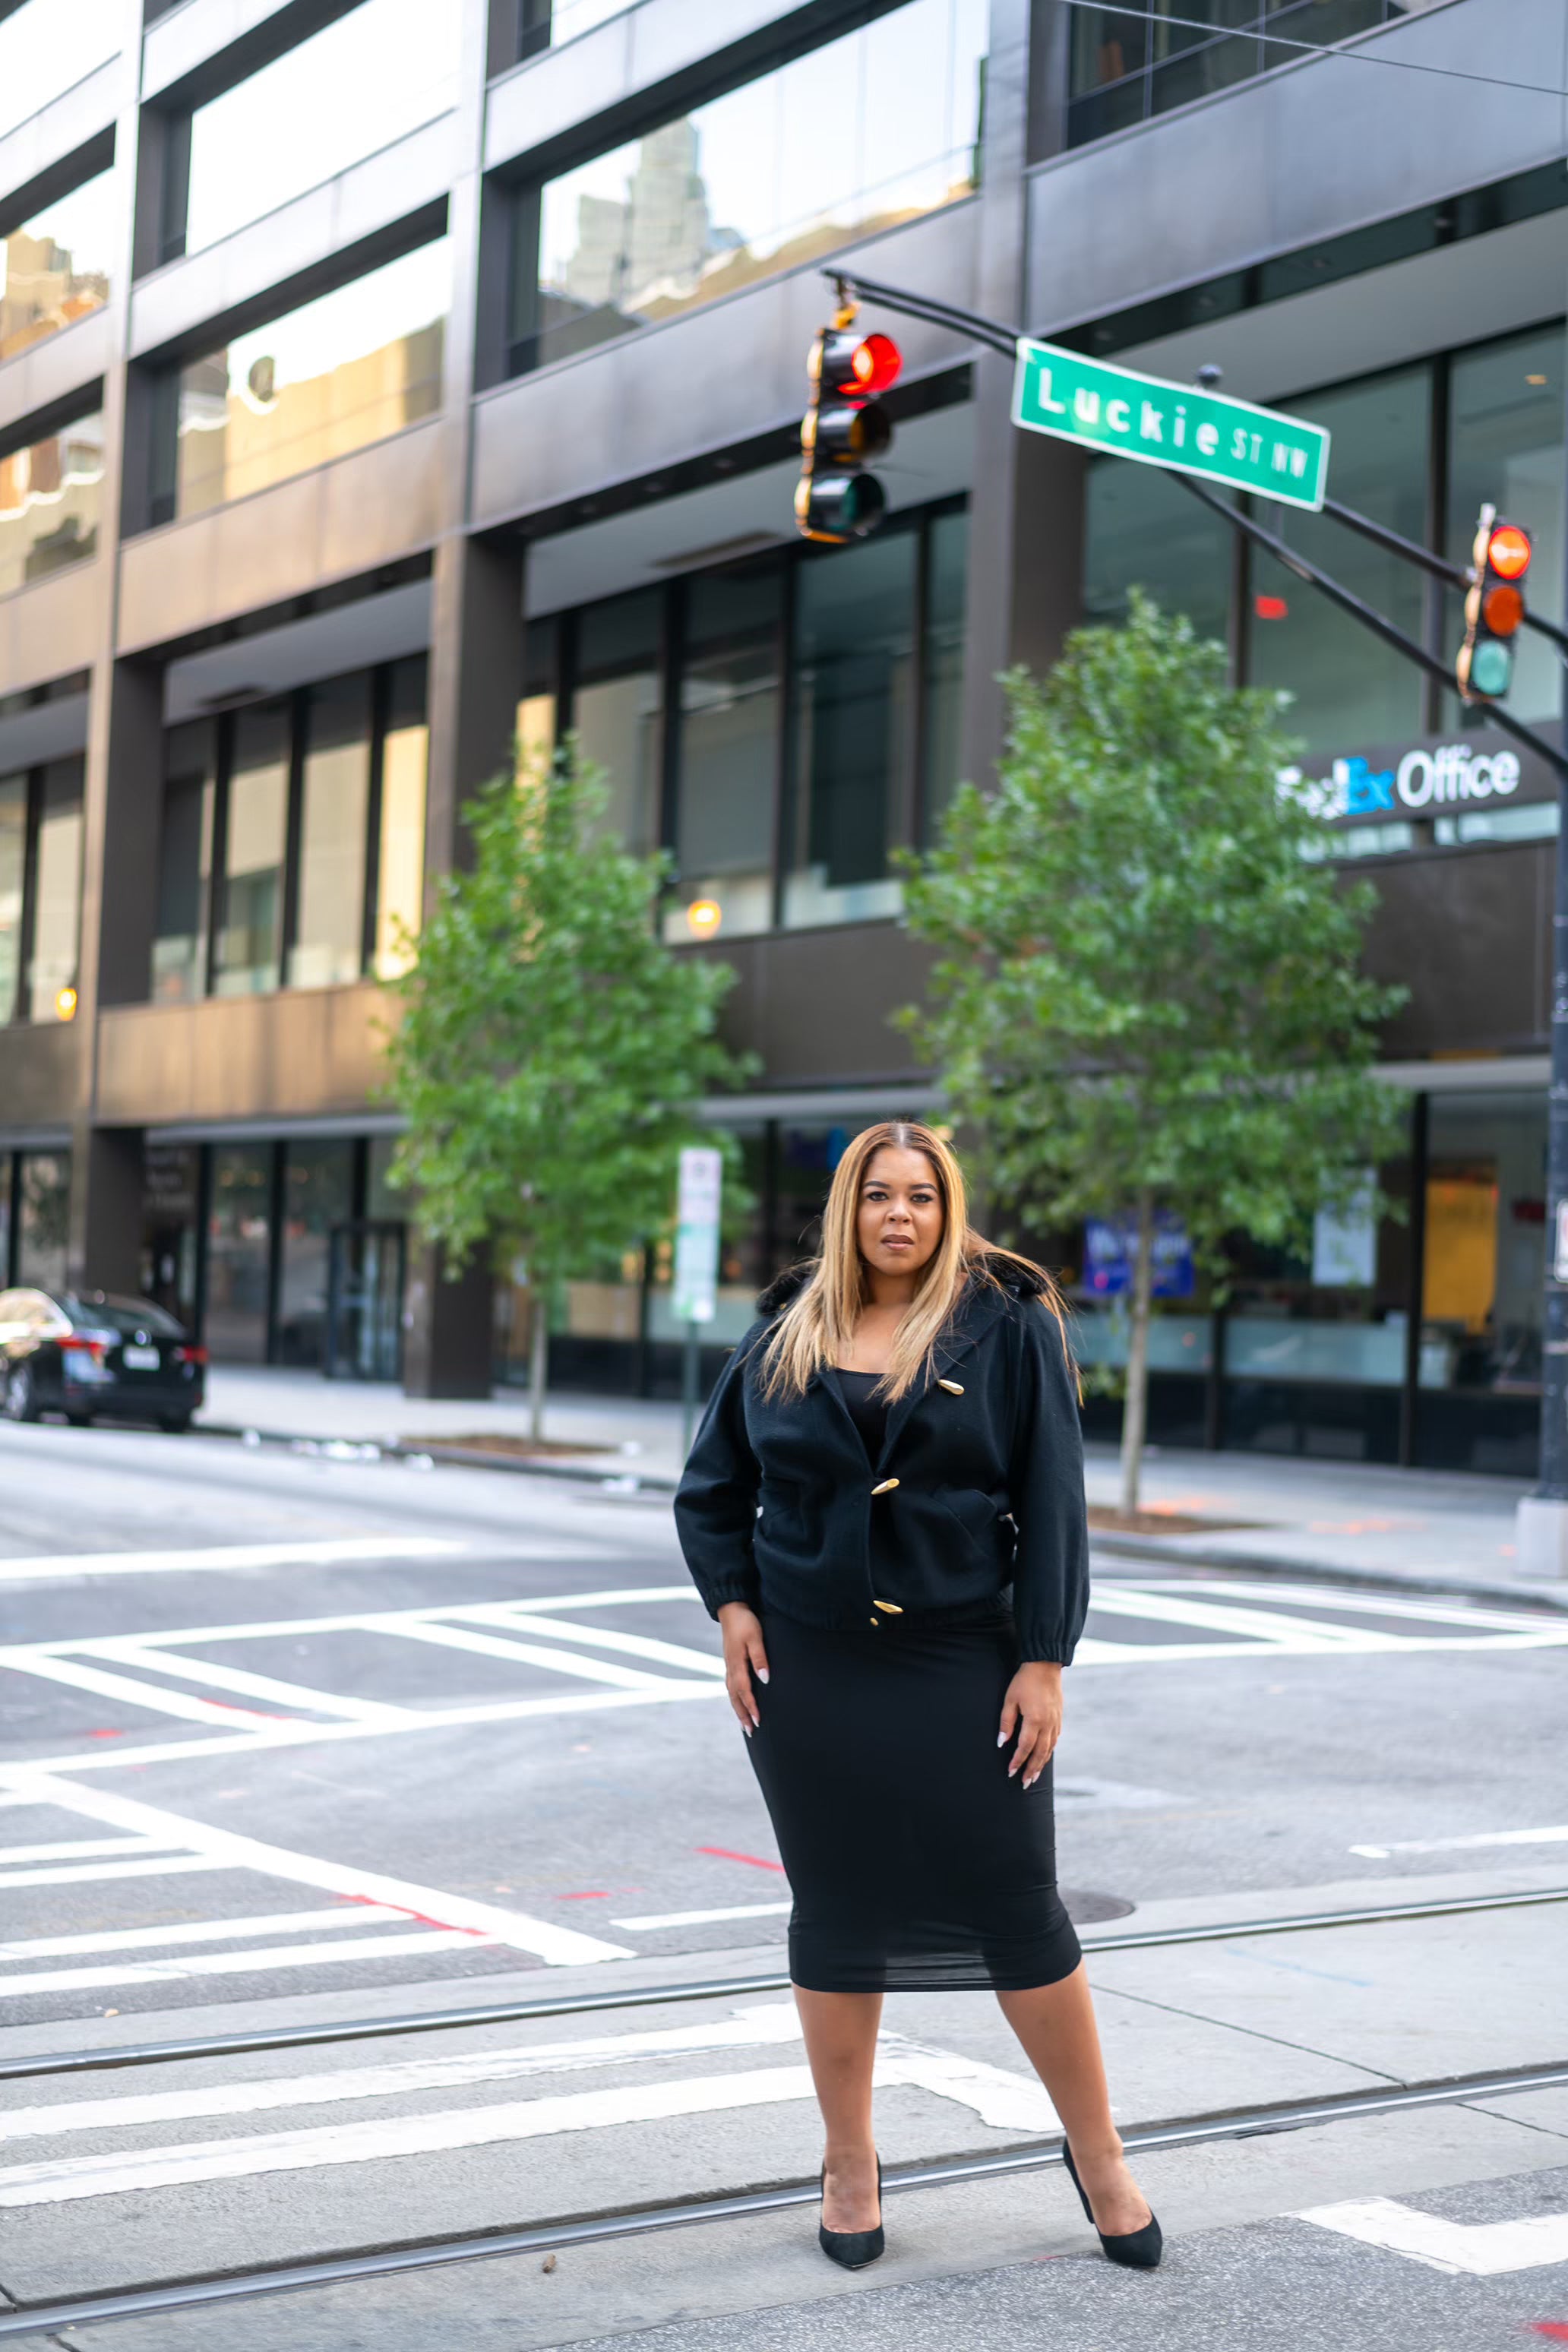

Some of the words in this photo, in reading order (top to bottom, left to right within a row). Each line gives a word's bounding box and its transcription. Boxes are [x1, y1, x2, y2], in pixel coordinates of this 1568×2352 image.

[1038, 366, 1219, 456] Luckie
[1230, 428, 1264, 464] ST
[1270, 442, 1309, 478] NW
[1396, 744, 1519, 808] Office
